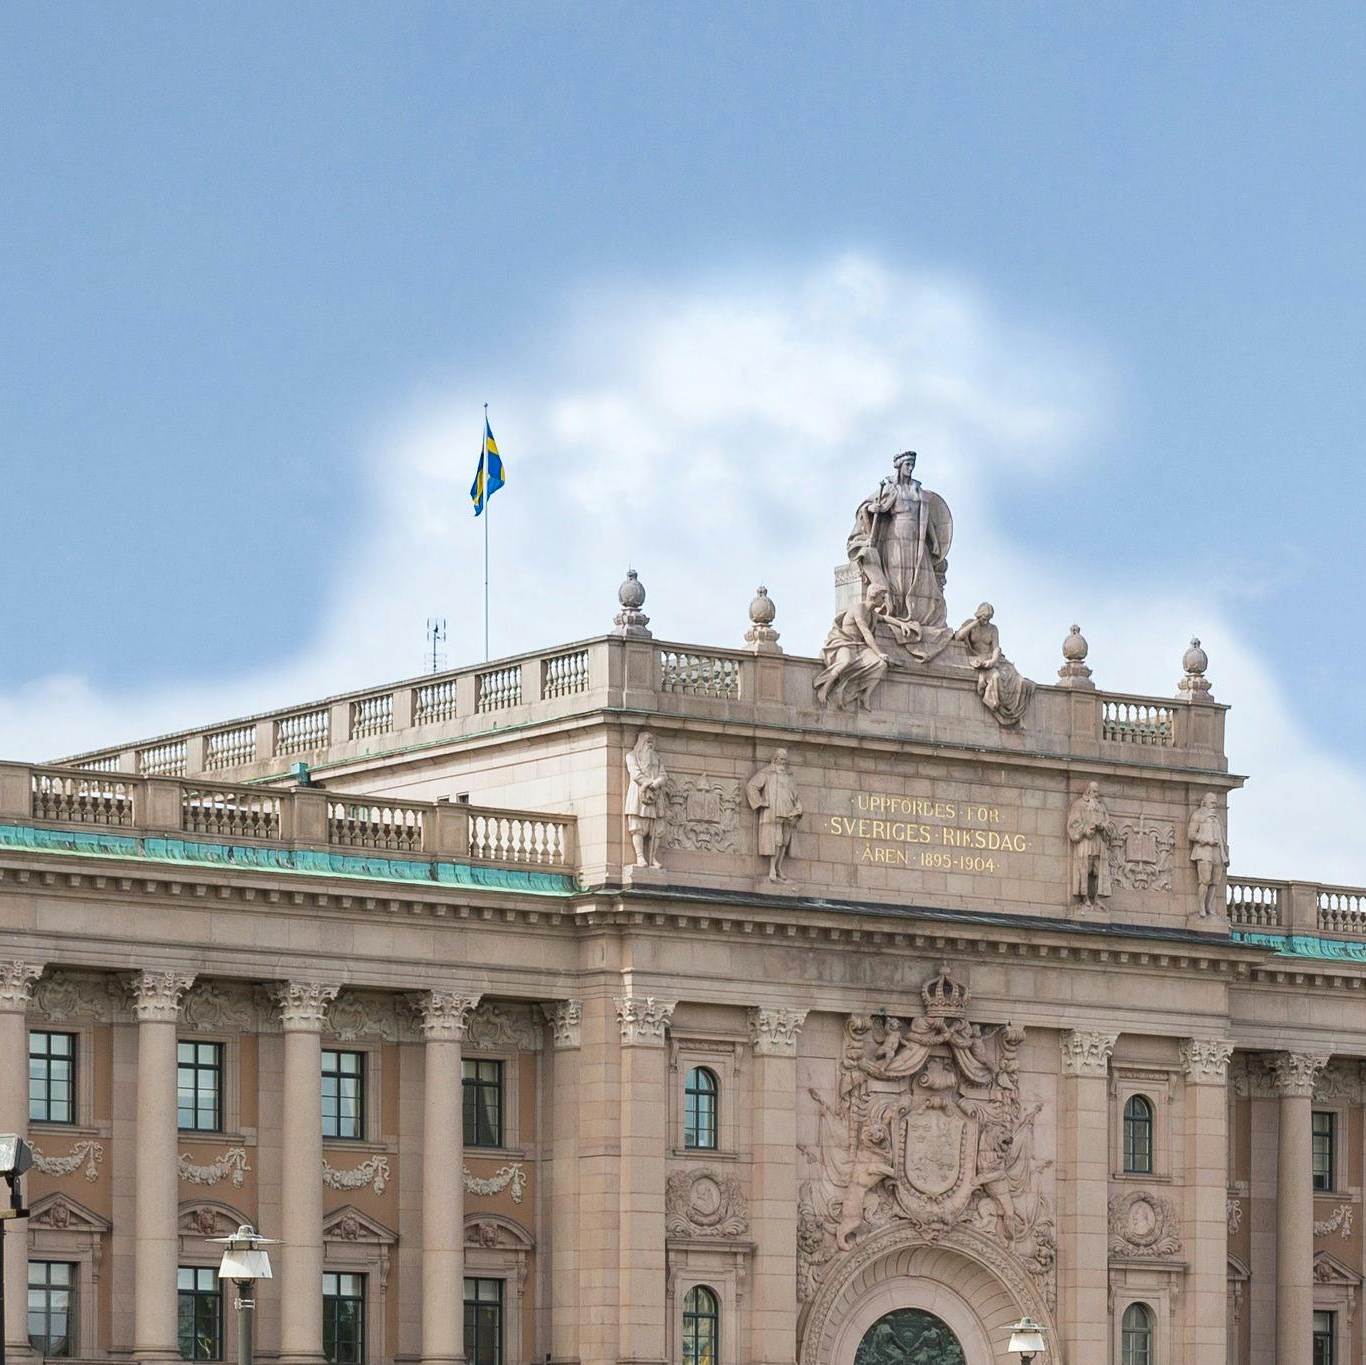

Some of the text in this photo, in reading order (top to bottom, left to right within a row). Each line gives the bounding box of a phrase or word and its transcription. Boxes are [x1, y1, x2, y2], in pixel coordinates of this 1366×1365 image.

[830, 816, 1027, 852] SVERIGES RIKSDAG
[861, 842, 996, 873] ÅREN 1895-1904
